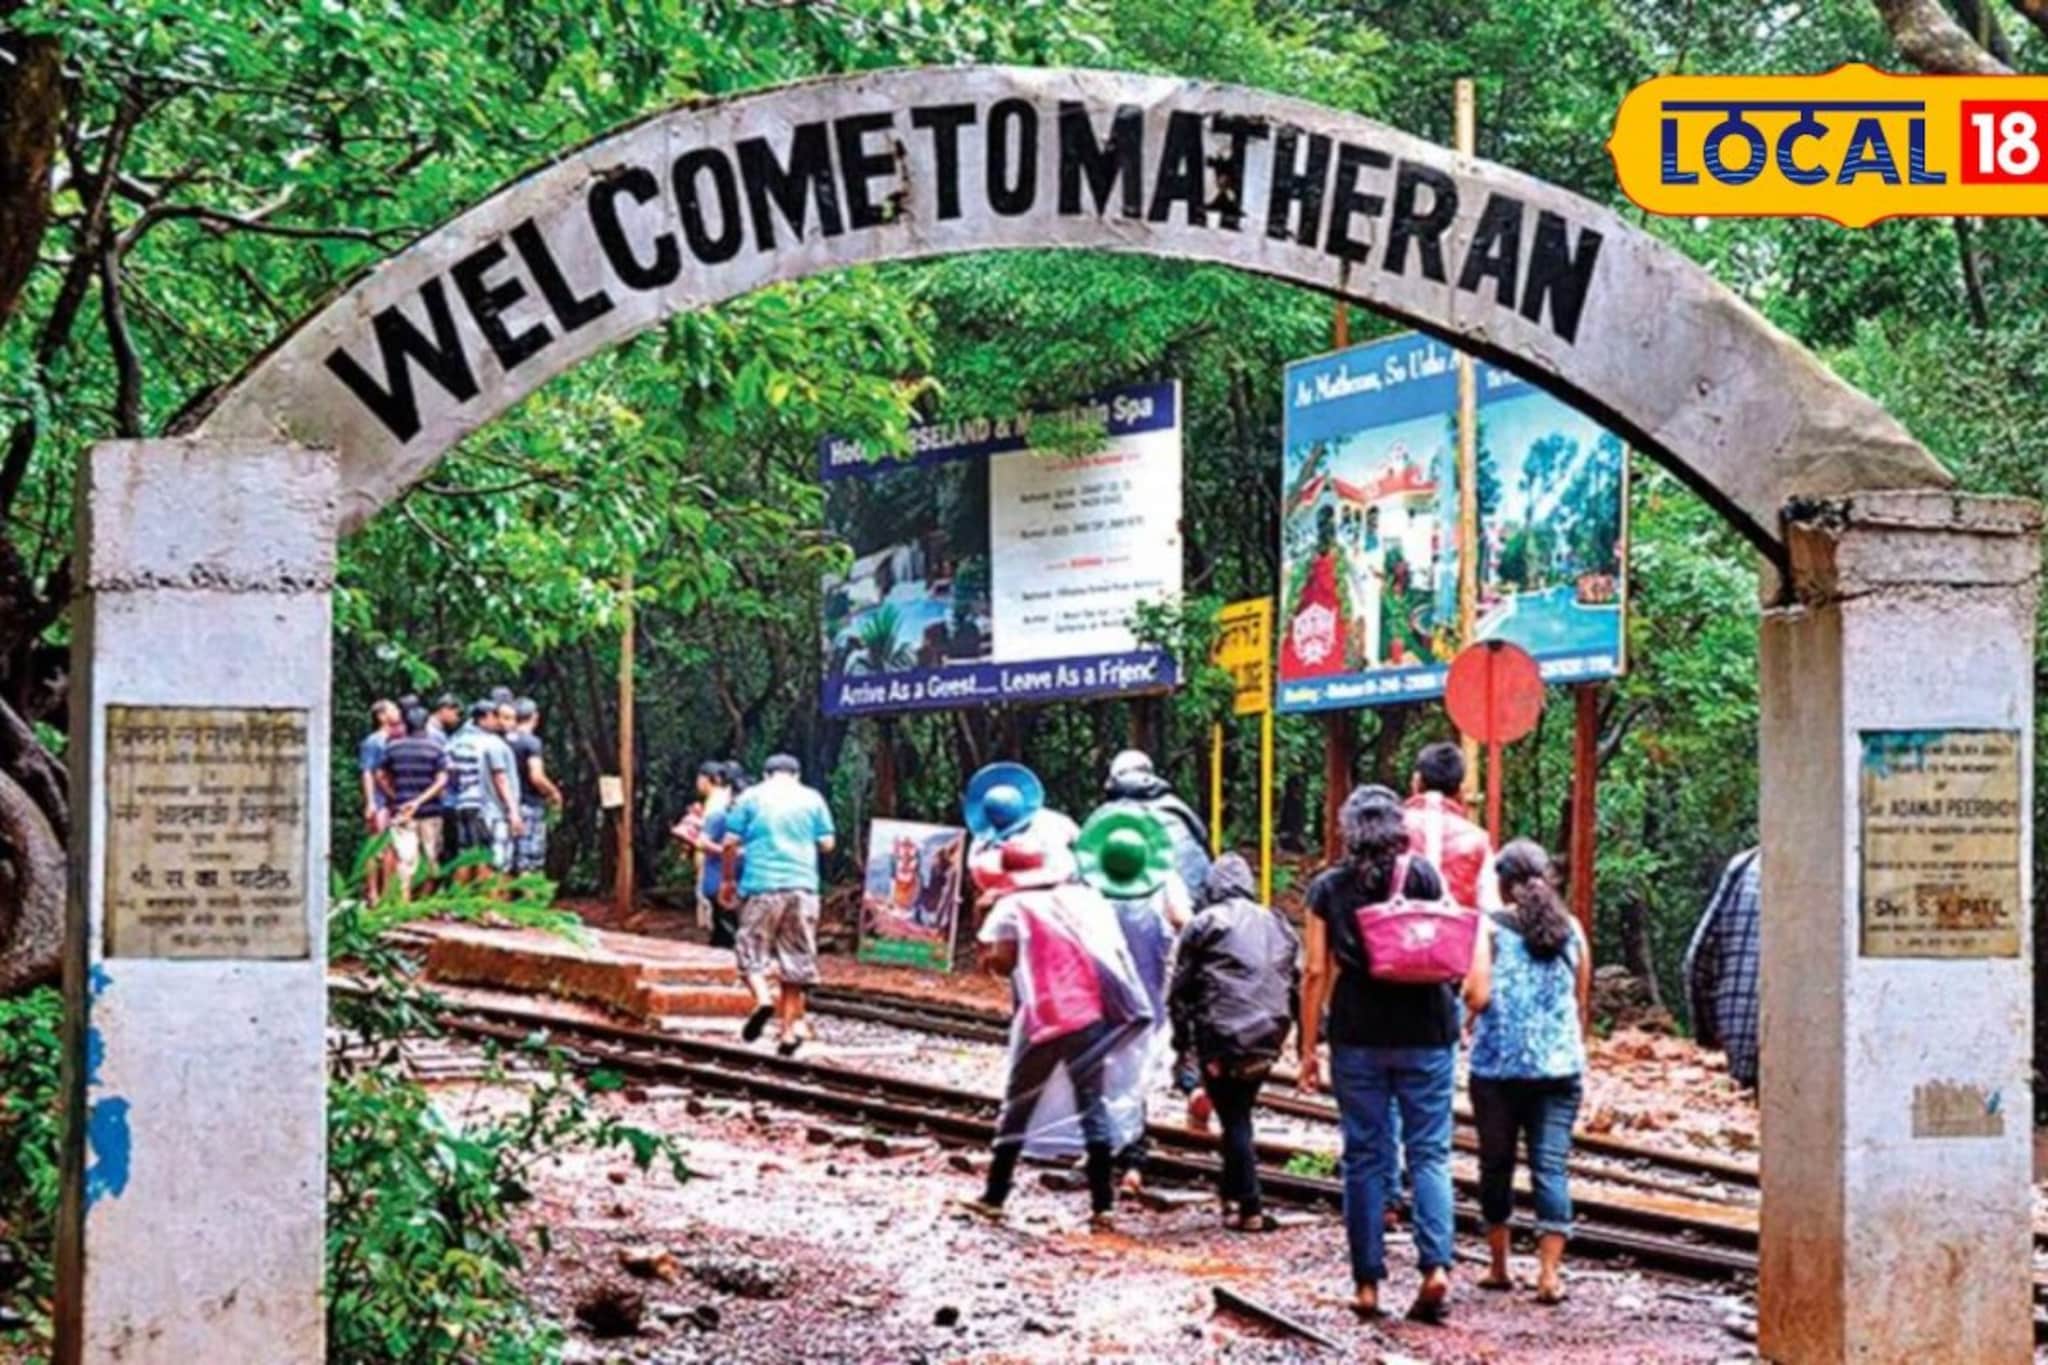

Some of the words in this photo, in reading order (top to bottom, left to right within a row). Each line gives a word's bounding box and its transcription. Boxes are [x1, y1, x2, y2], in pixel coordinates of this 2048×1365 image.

[325, 109, 908, 443] WELCOME
[911, 99, 1038, 222] TO
[1059, 106, 1604, 345] MATHERAN
[995, 418, 1011, 437] &
[1113, 395, 1154, 426] Spa
[841, 684, 886, 707] Arrive
[888, 682, 911, 702] As
[914, 684, 924, 699] a
[1001, 669, 1052, 693] Leave
[1055, 665, 1080, 687] As
[1083, 670, 1094, 685] a
